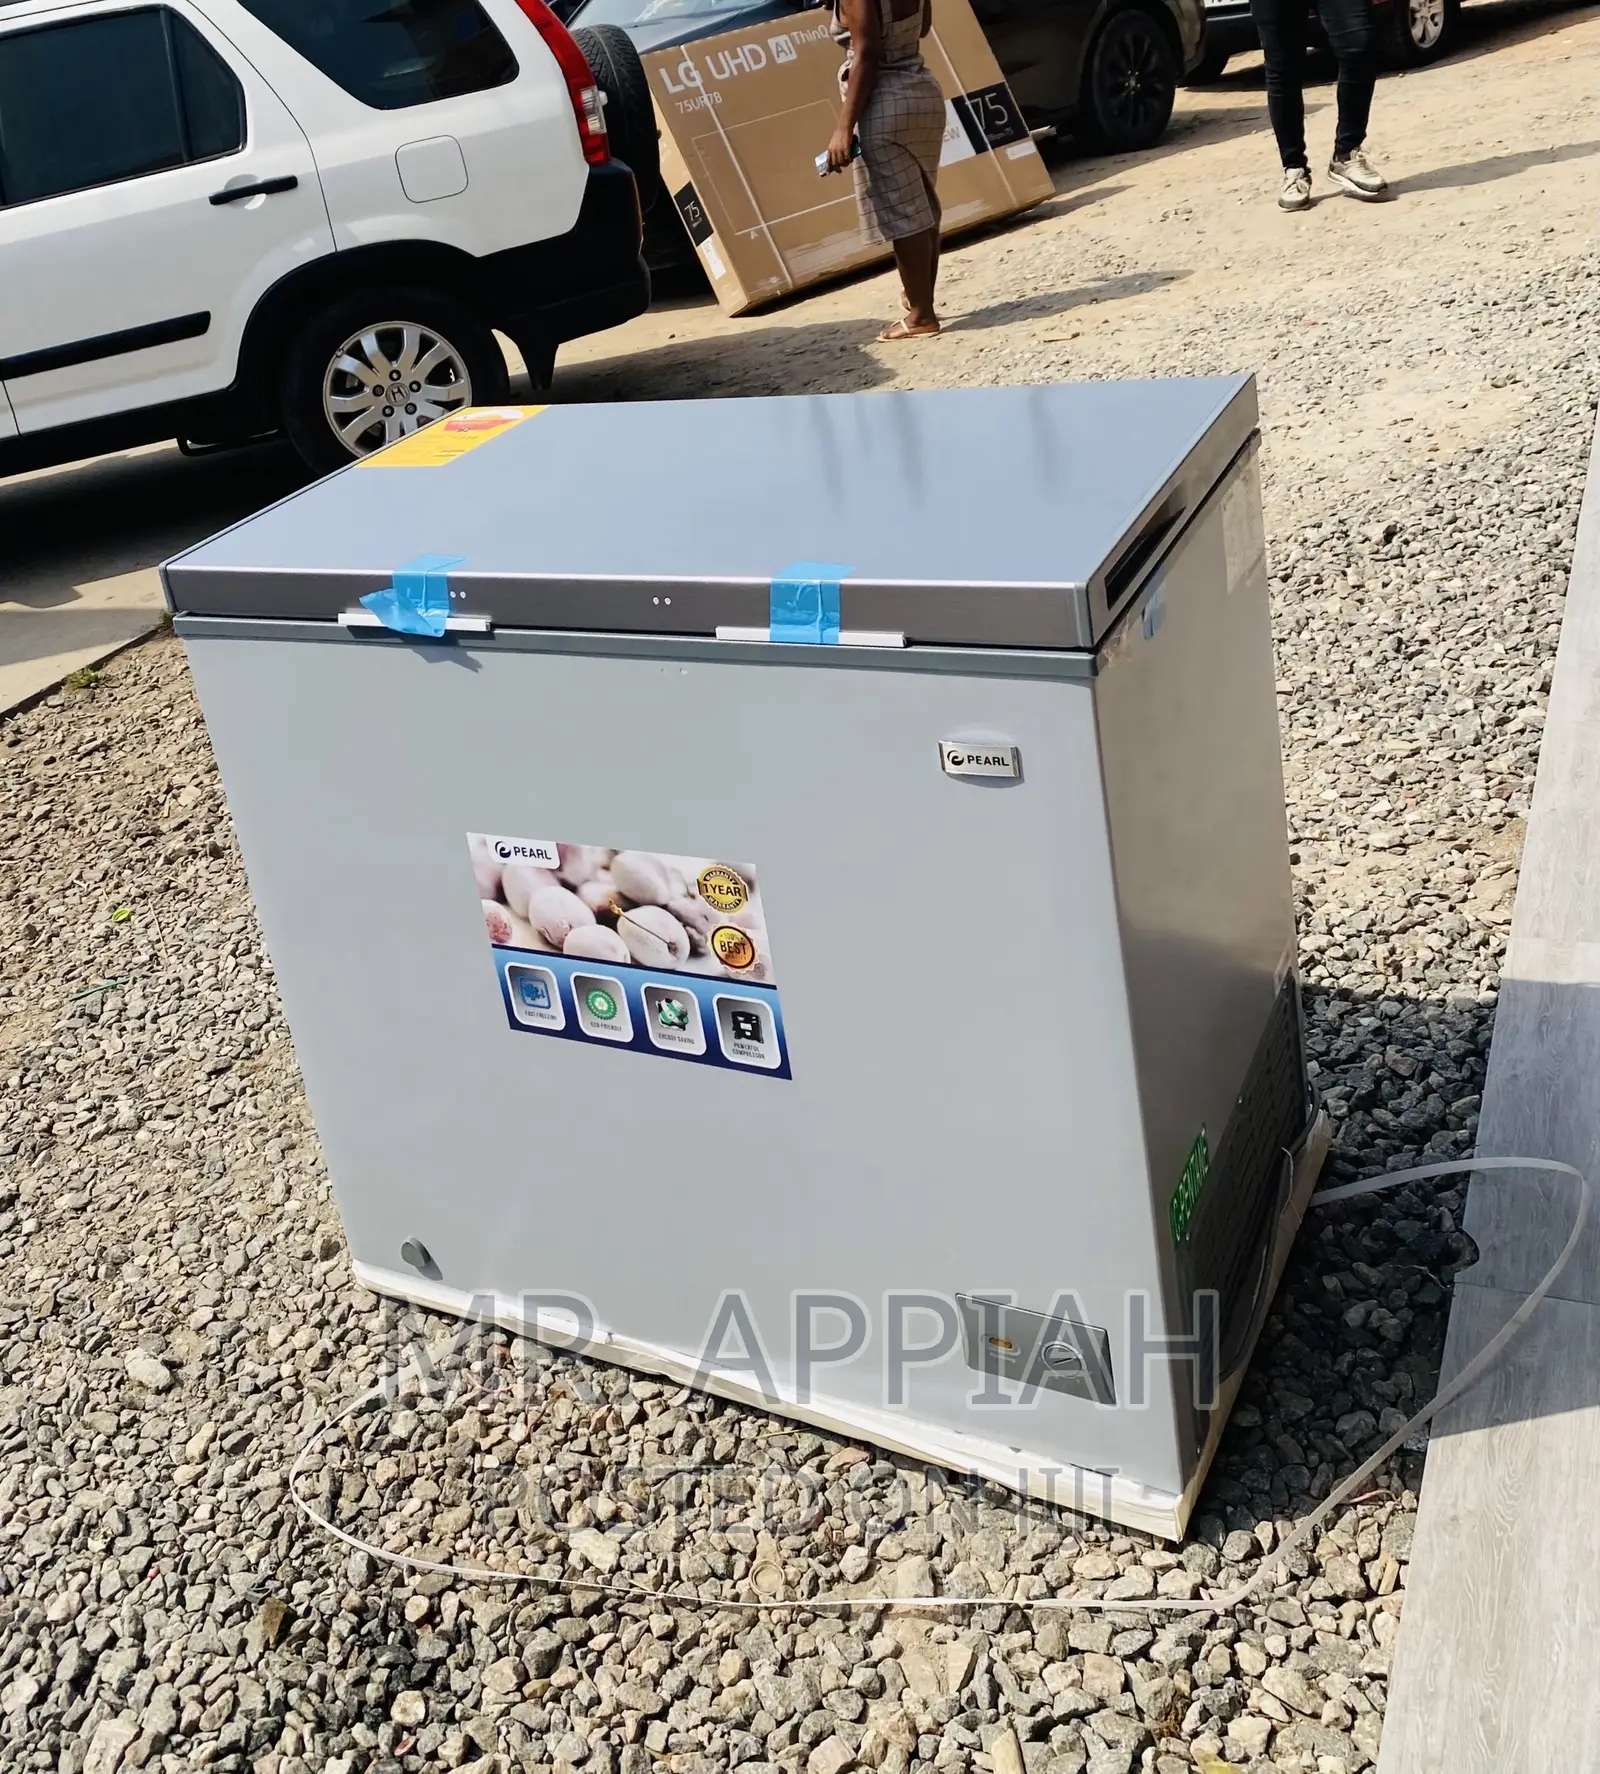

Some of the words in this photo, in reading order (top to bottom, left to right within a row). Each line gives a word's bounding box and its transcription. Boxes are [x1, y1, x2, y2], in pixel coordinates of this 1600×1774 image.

[659, 61, 703, 94] LG
[705, 44, 768, 80] UHD
[791, 25, 830, 45] ThinQ
[965, 92, 1009, 130] 75
[684, 200, 701, 222] 75
[967, 755, 1010, 767] PEARL
[513, 846, 552, 860] PEARL
[703, 883, 709, 894] 1
[709, 884, 742, 897] YEAR
[720, 941, 746, 955] BEST
